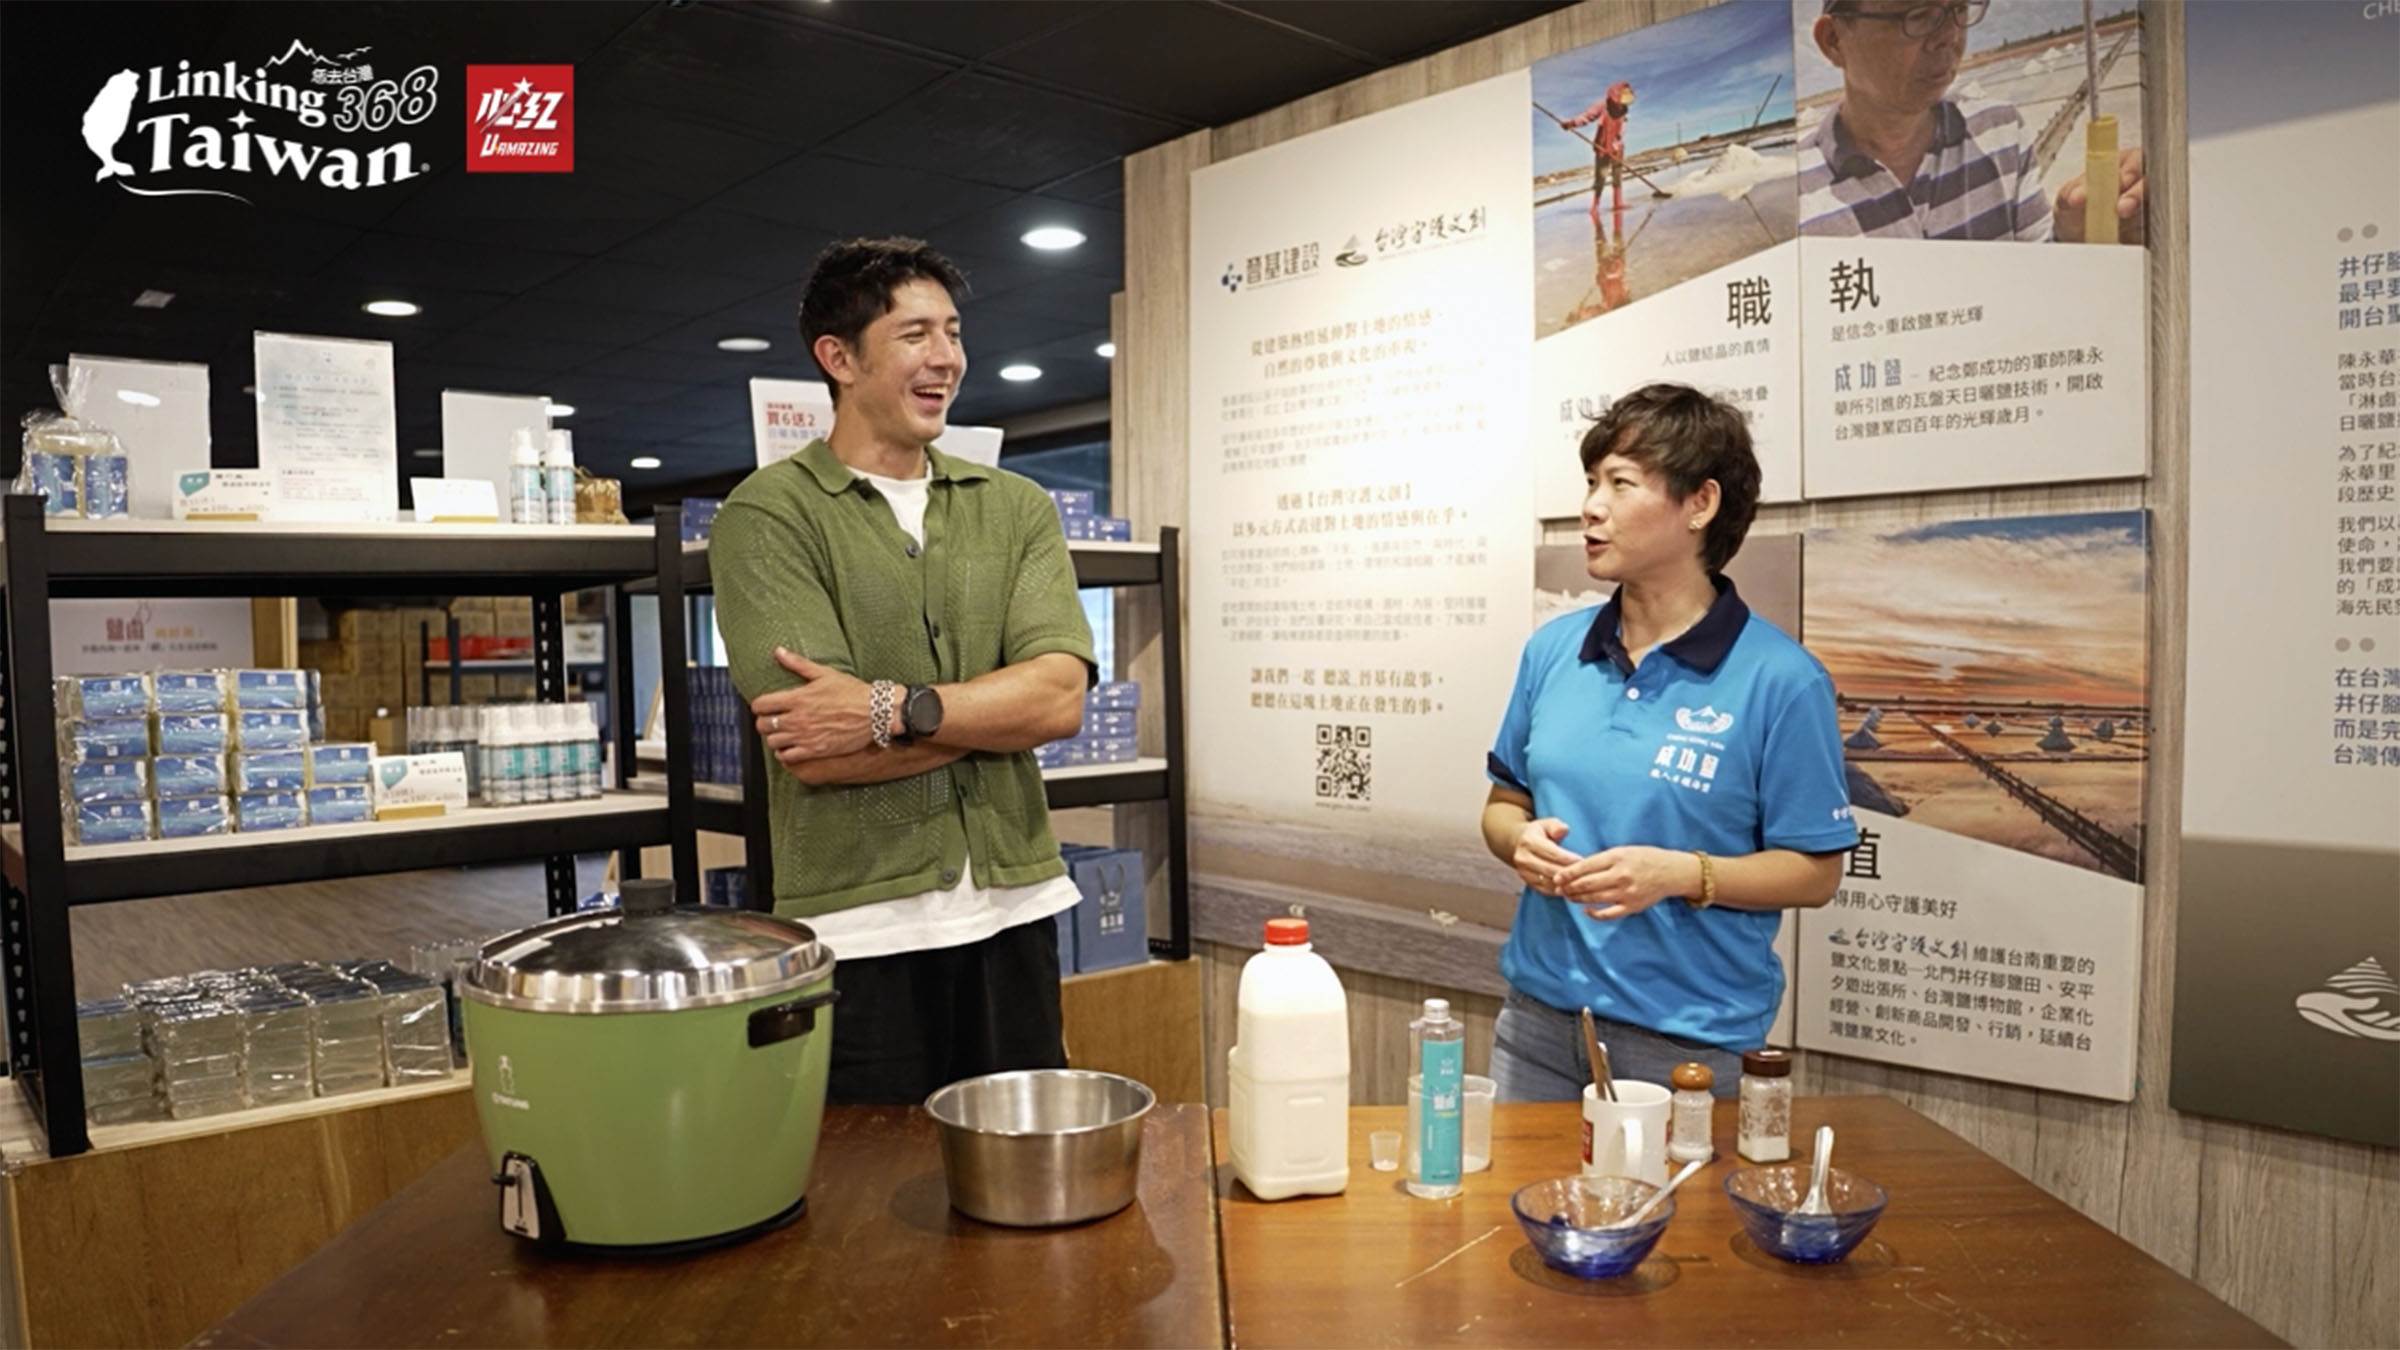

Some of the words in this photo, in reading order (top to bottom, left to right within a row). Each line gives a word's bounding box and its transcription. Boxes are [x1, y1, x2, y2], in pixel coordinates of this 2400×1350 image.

[1829, 257, 1880, 314] 執
[1727, 275, 1771, 329] 職
[2338, 349, 2400, 370] 陳永華
[2338, 370, 2400, 391] 當時台
[2338, 442, 2400, 462] 為了紀
[2338, 515, 2400, 534] 我們以
[2337, 536, 2400, 555] 使命，
[2338, 557, 2400, 576] 我們要
[2336, 576, 2400, 596] 的「成
